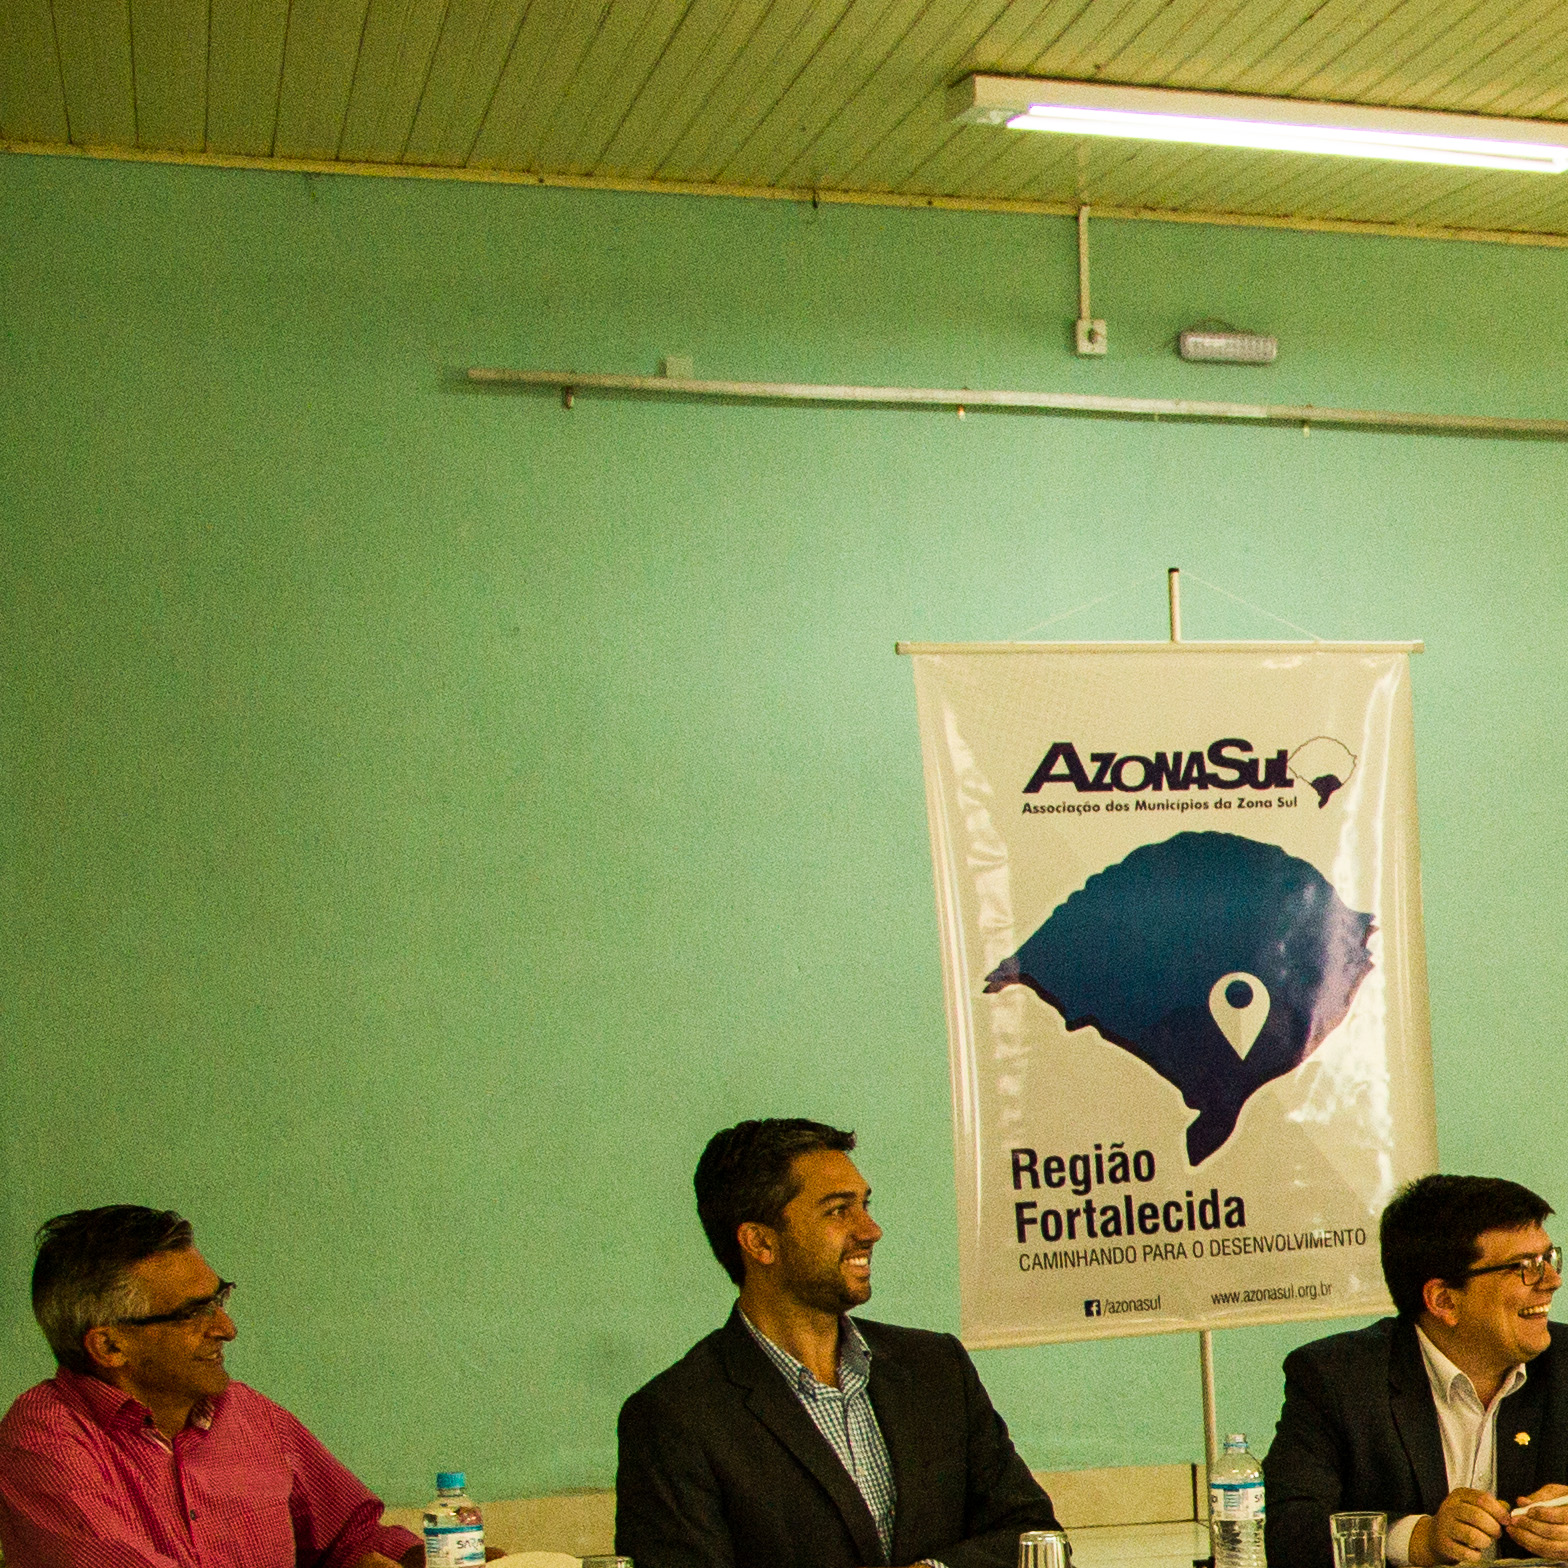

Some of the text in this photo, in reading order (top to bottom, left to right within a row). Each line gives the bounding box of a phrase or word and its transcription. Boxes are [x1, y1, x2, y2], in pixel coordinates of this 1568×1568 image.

[1022, 796, 1298, 816] Associação dos Municípios da Zona Sul
[1011, 1142, 1156, 1196] Região
[1015, 1188, 1247, 1244] Fortalecida
[1019, 1228, 1367, 1273] CAMINHANDO PARA O DESENVOLVIMENTO
[1211, 1281, 1333, 1306] www.azonasul.org.br
